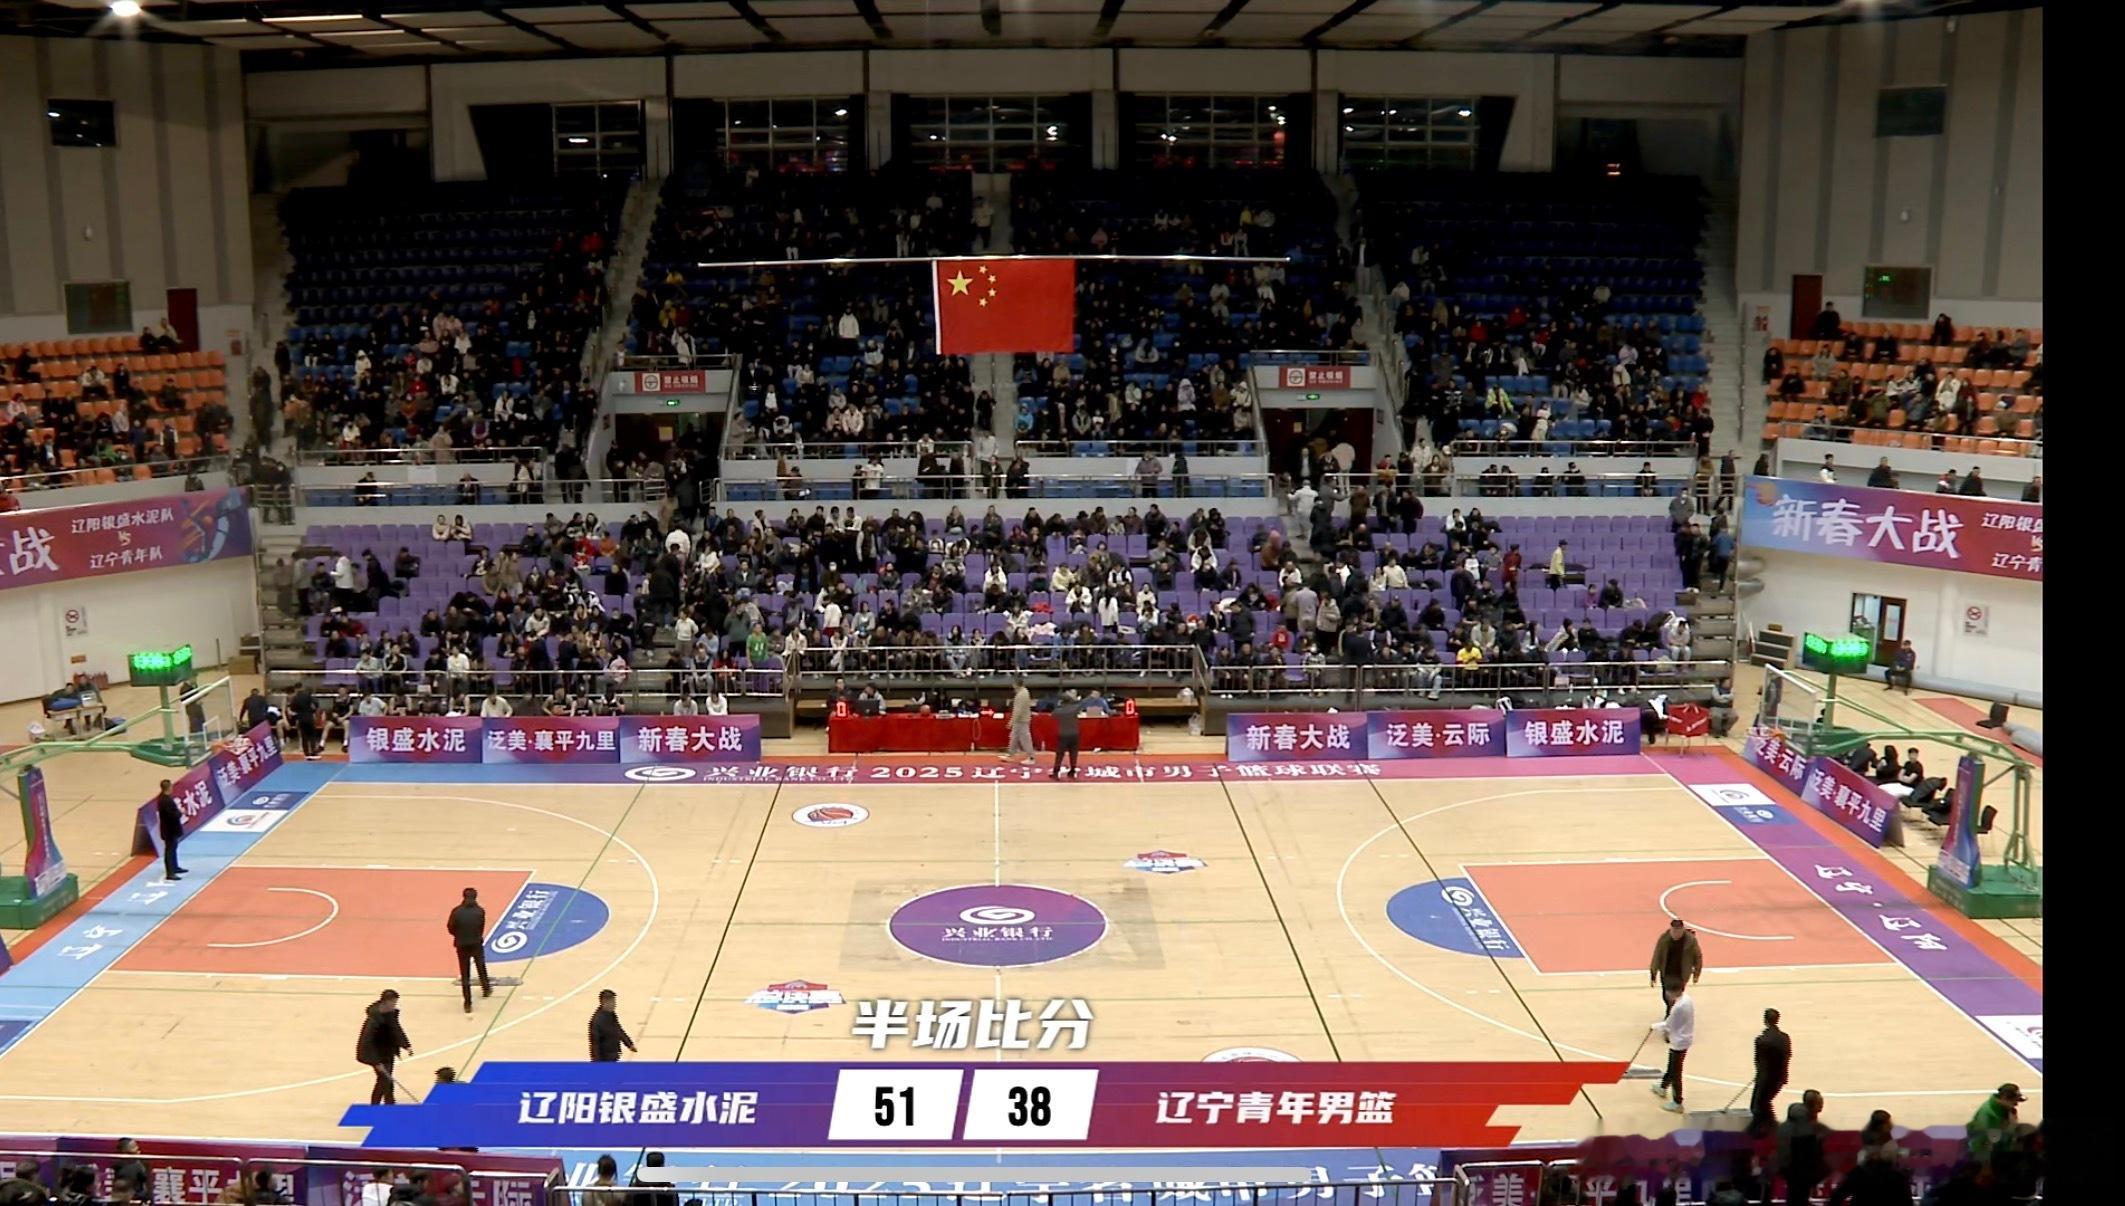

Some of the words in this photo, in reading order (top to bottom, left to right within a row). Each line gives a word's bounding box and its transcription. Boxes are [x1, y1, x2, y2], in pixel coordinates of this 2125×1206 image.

[71, 507, 174, 534] 辽阳银盛水泥队
[1772, 494, 1963, 559] 新春大战
[0, 526, 58, 575] 战
[89, 546, 163, 569] 辽宁青年队
[366, 727, 467, 752] 银盛水泥
[487, 729, 617, 752] 泛美·襄平九里
[638, 726, 743, 752] 新春大战
[1246, 724, 1351, 750] 新春大战
[1386, 722, 1491, 747] 泛美·云际
[1524, 720, 1625, 746] 银盛水泥
[704, 765, 859, 778] 兴业银行
[942, 926, 1054, 938] 兴业银行
